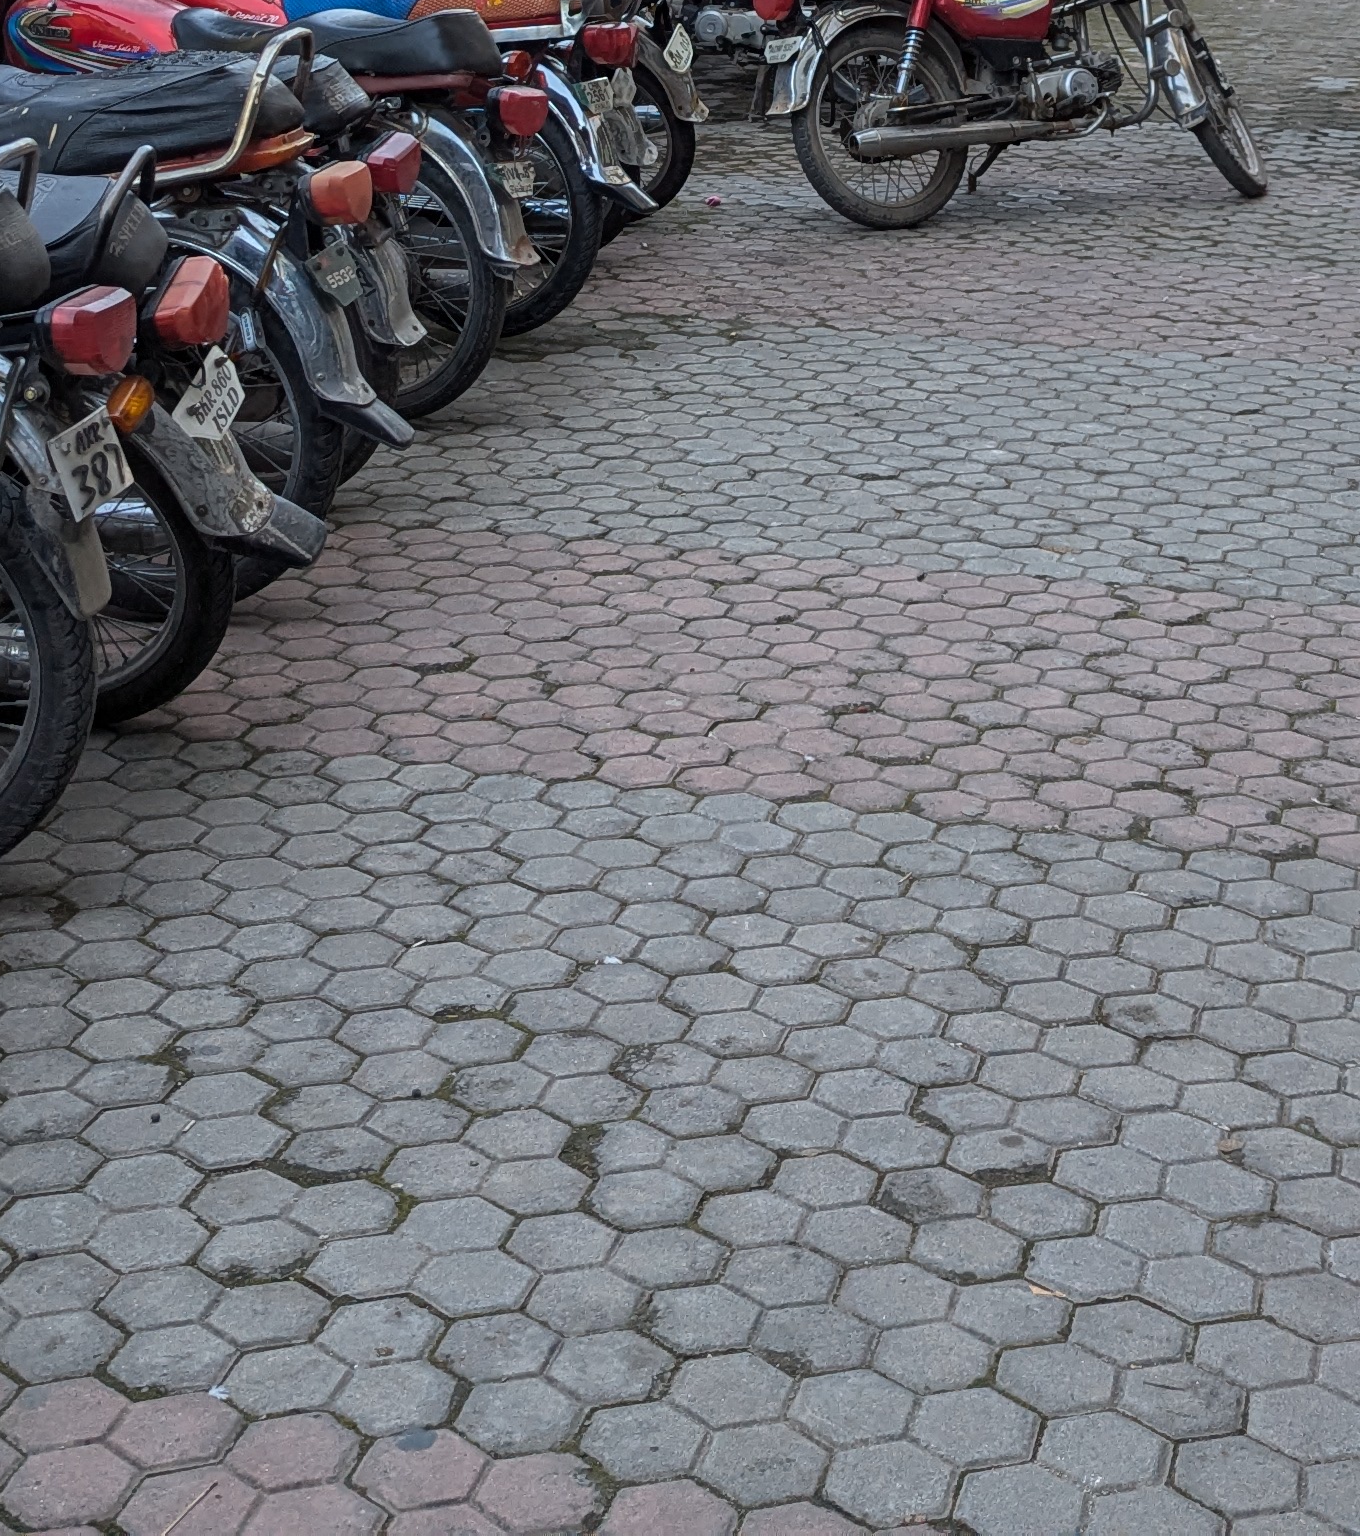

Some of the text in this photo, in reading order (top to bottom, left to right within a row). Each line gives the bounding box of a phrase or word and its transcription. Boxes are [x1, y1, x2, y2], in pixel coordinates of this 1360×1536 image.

[588, 90, 612, 105] 2561
[325, 265, 357, 290] 5532
[213, 364, 233, 398] 860
[211, 386, 240, 434] ISLD
[71, 442, 127, 512] 387
